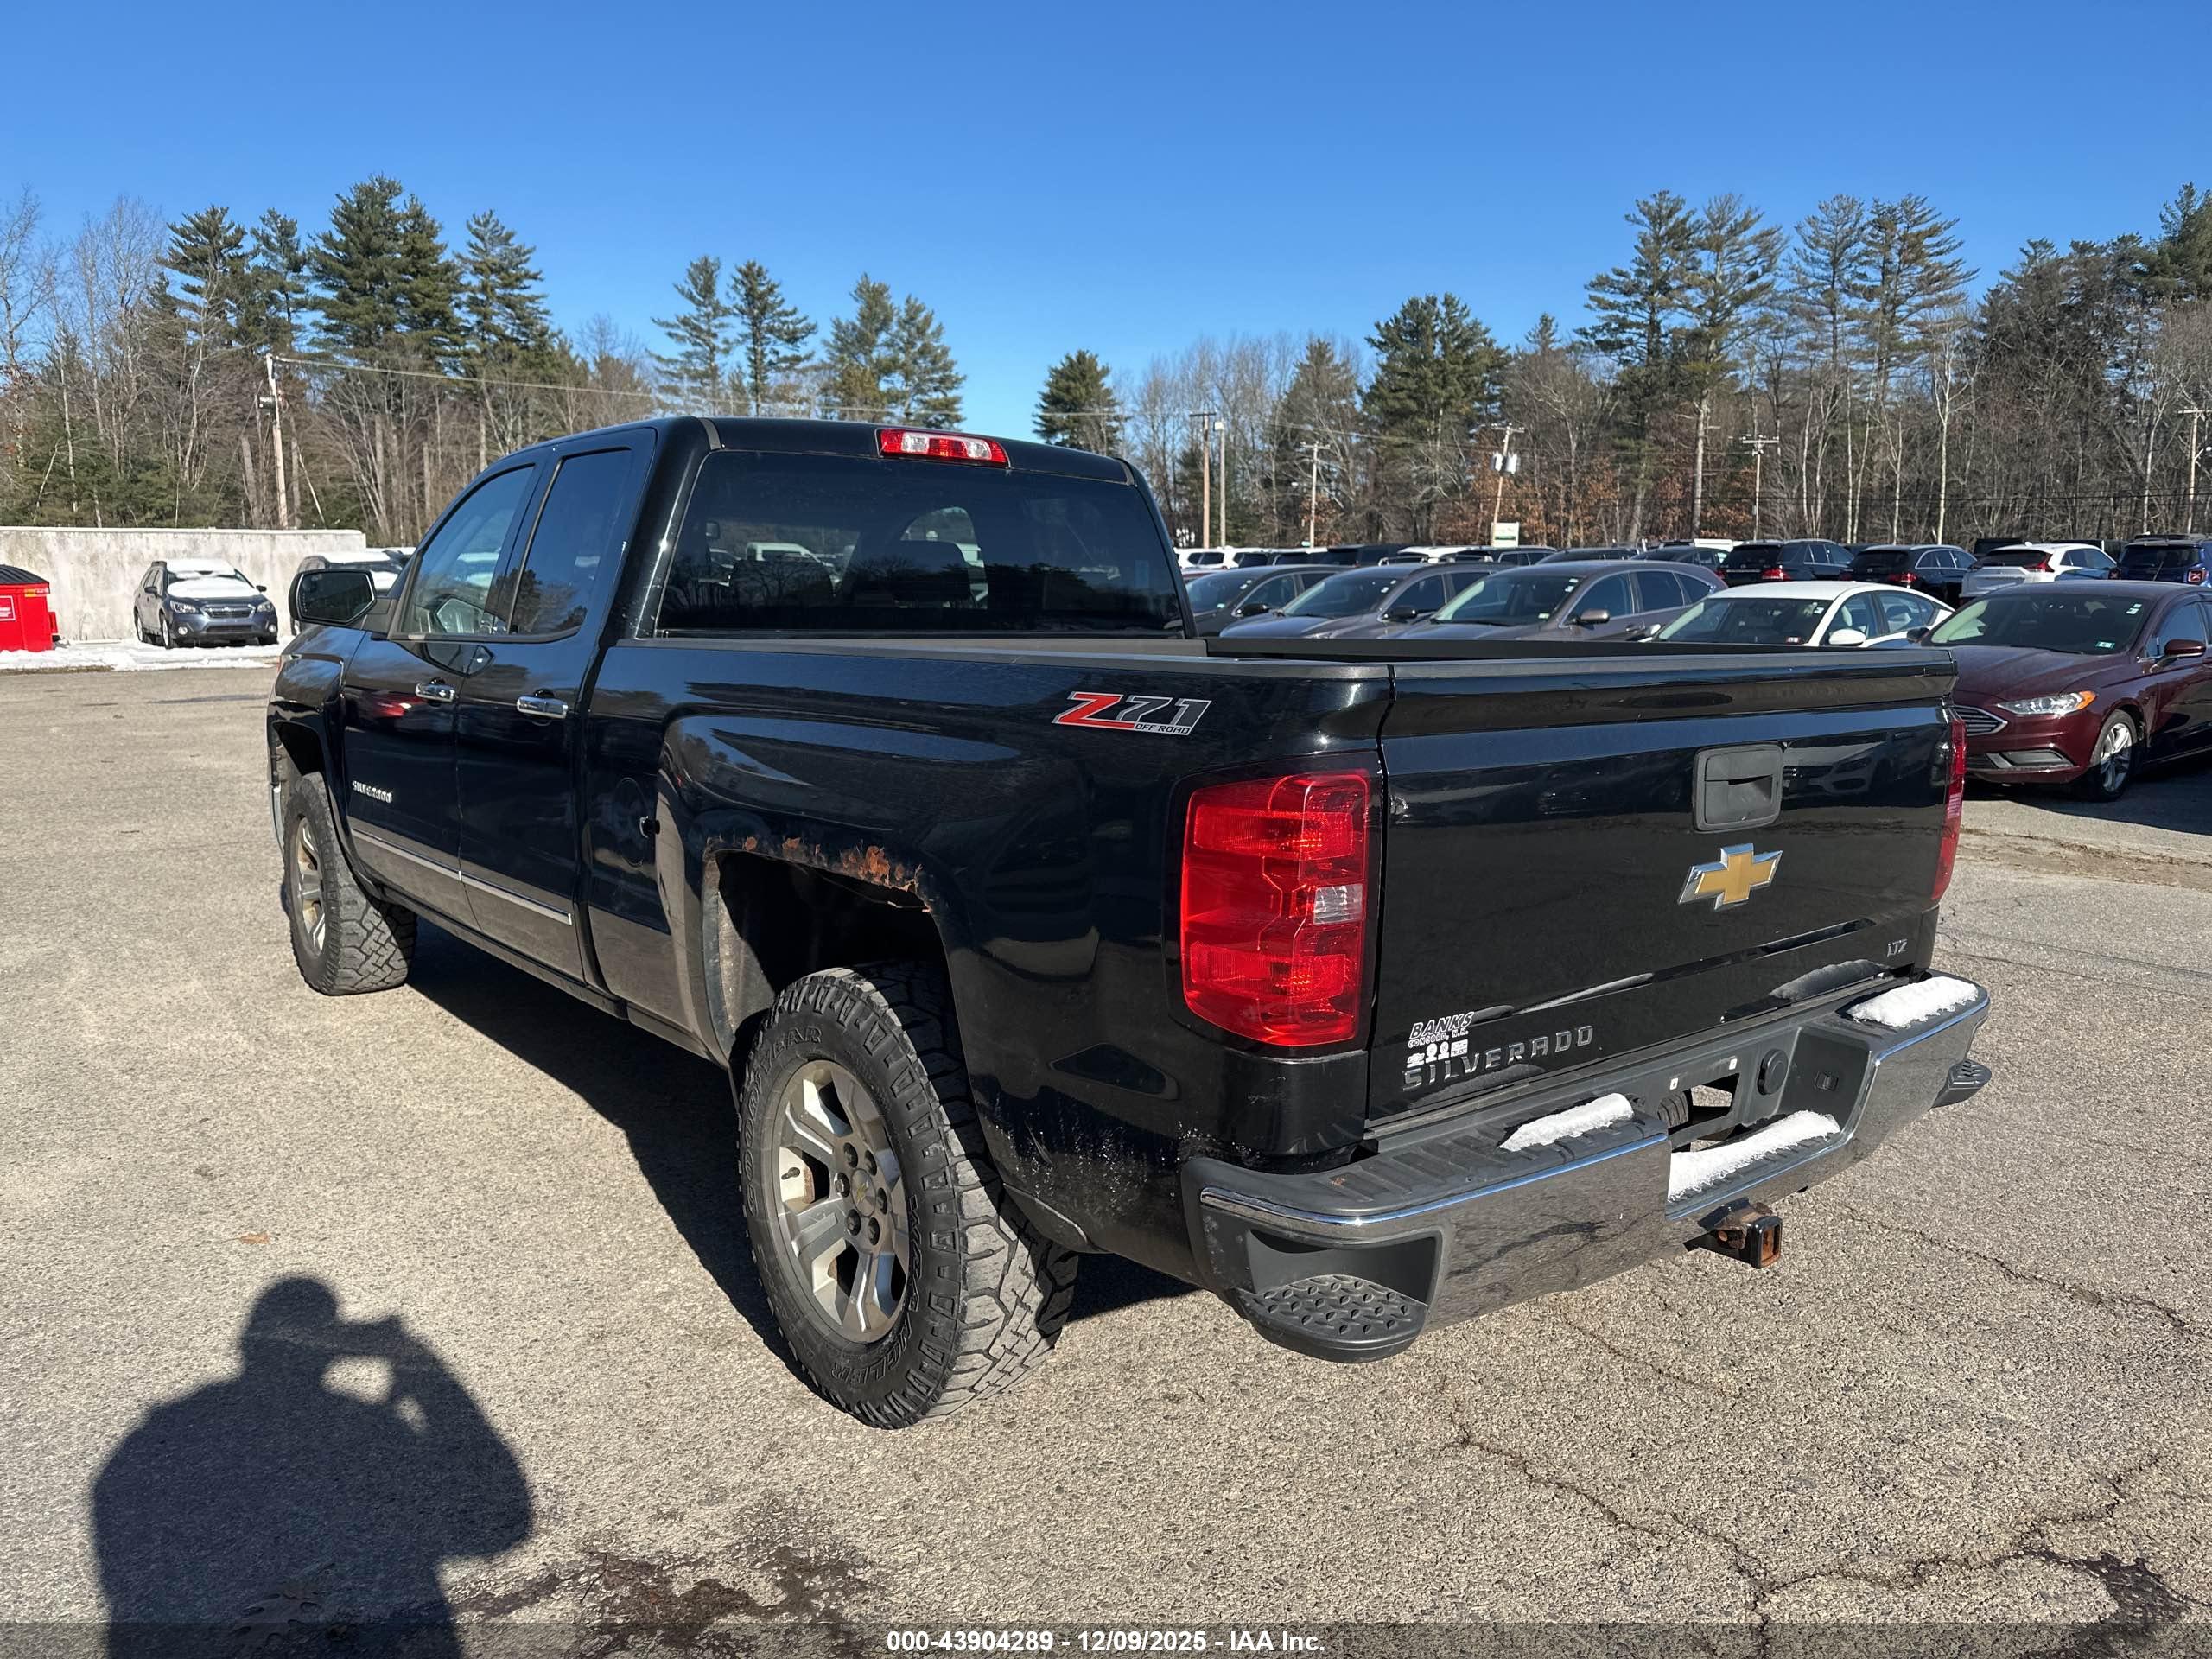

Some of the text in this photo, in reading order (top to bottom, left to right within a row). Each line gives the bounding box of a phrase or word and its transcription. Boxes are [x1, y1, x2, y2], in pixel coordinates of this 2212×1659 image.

[1052, 690, 1212, 733] Z71
[1135, 723, 1191, 735] OFF ROAD
[1409, 1011, 1475, 1039] BANKS
[1402, 1024, 1595, 1092] SILVERADO
